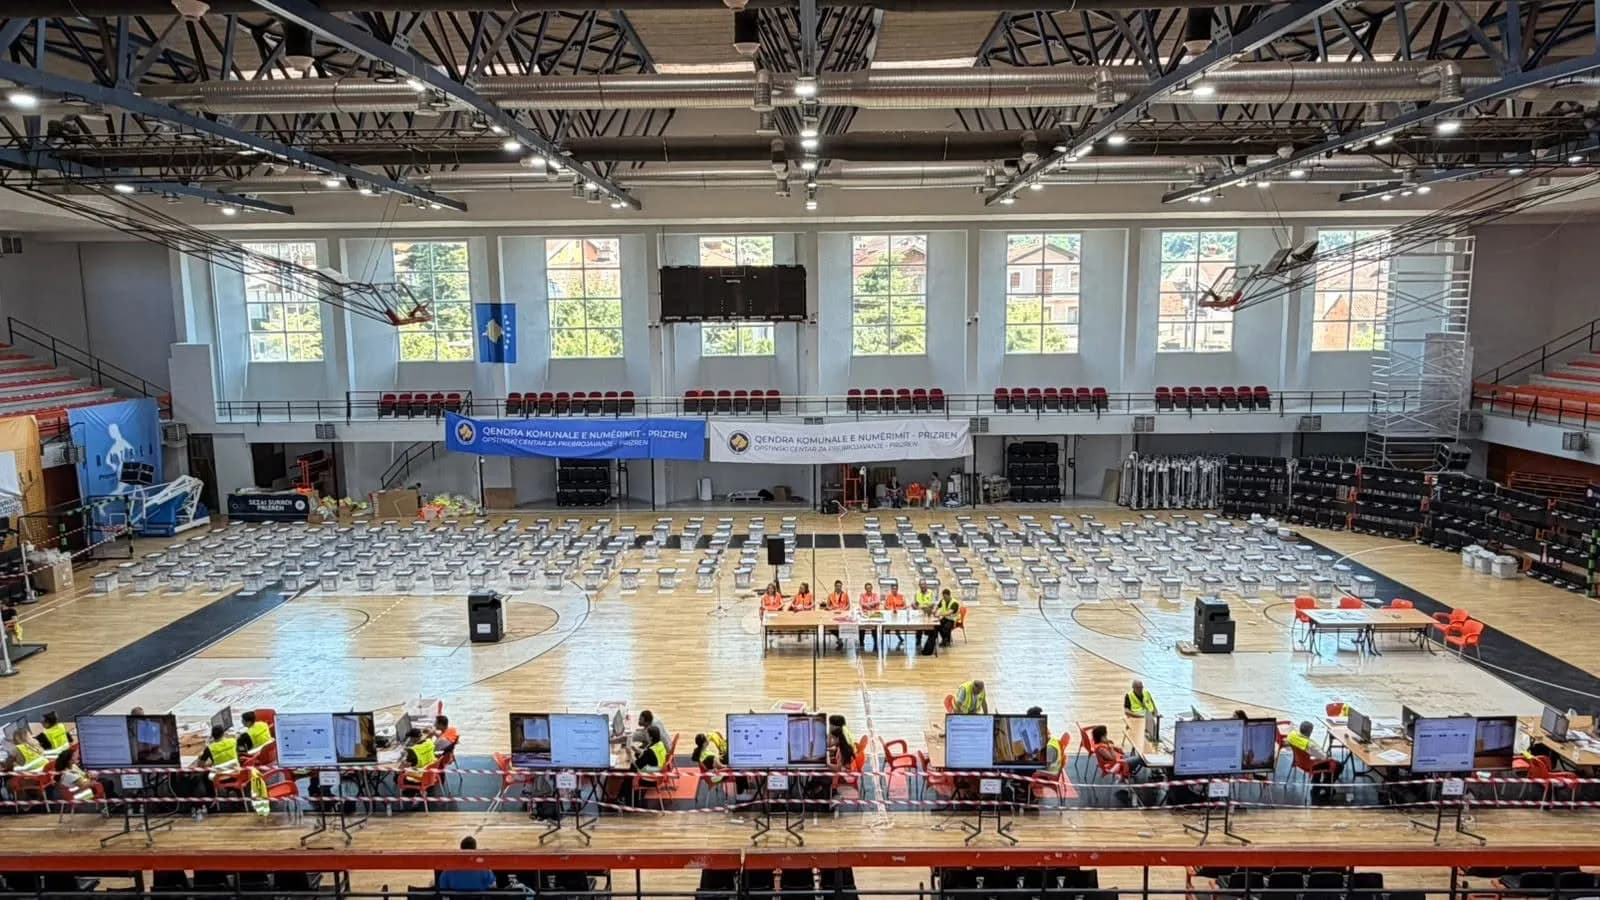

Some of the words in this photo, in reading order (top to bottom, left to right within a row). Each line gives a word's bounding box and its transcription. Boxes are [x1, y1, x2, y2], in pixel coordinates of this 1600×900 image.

[482, 426, 524, 437] QENDRA
[526, 428, 579, 440] KOMUNALE
[581, 431, 588, 440] E
[648, 429, 688, 440] PRIZREN
[754, 435, 794, 444] QENDRA
[796, 434, 848, 445] KOMUNALE
[850, 434, 857, 442] E
[918, 431, 958, 440] PRIZREN
